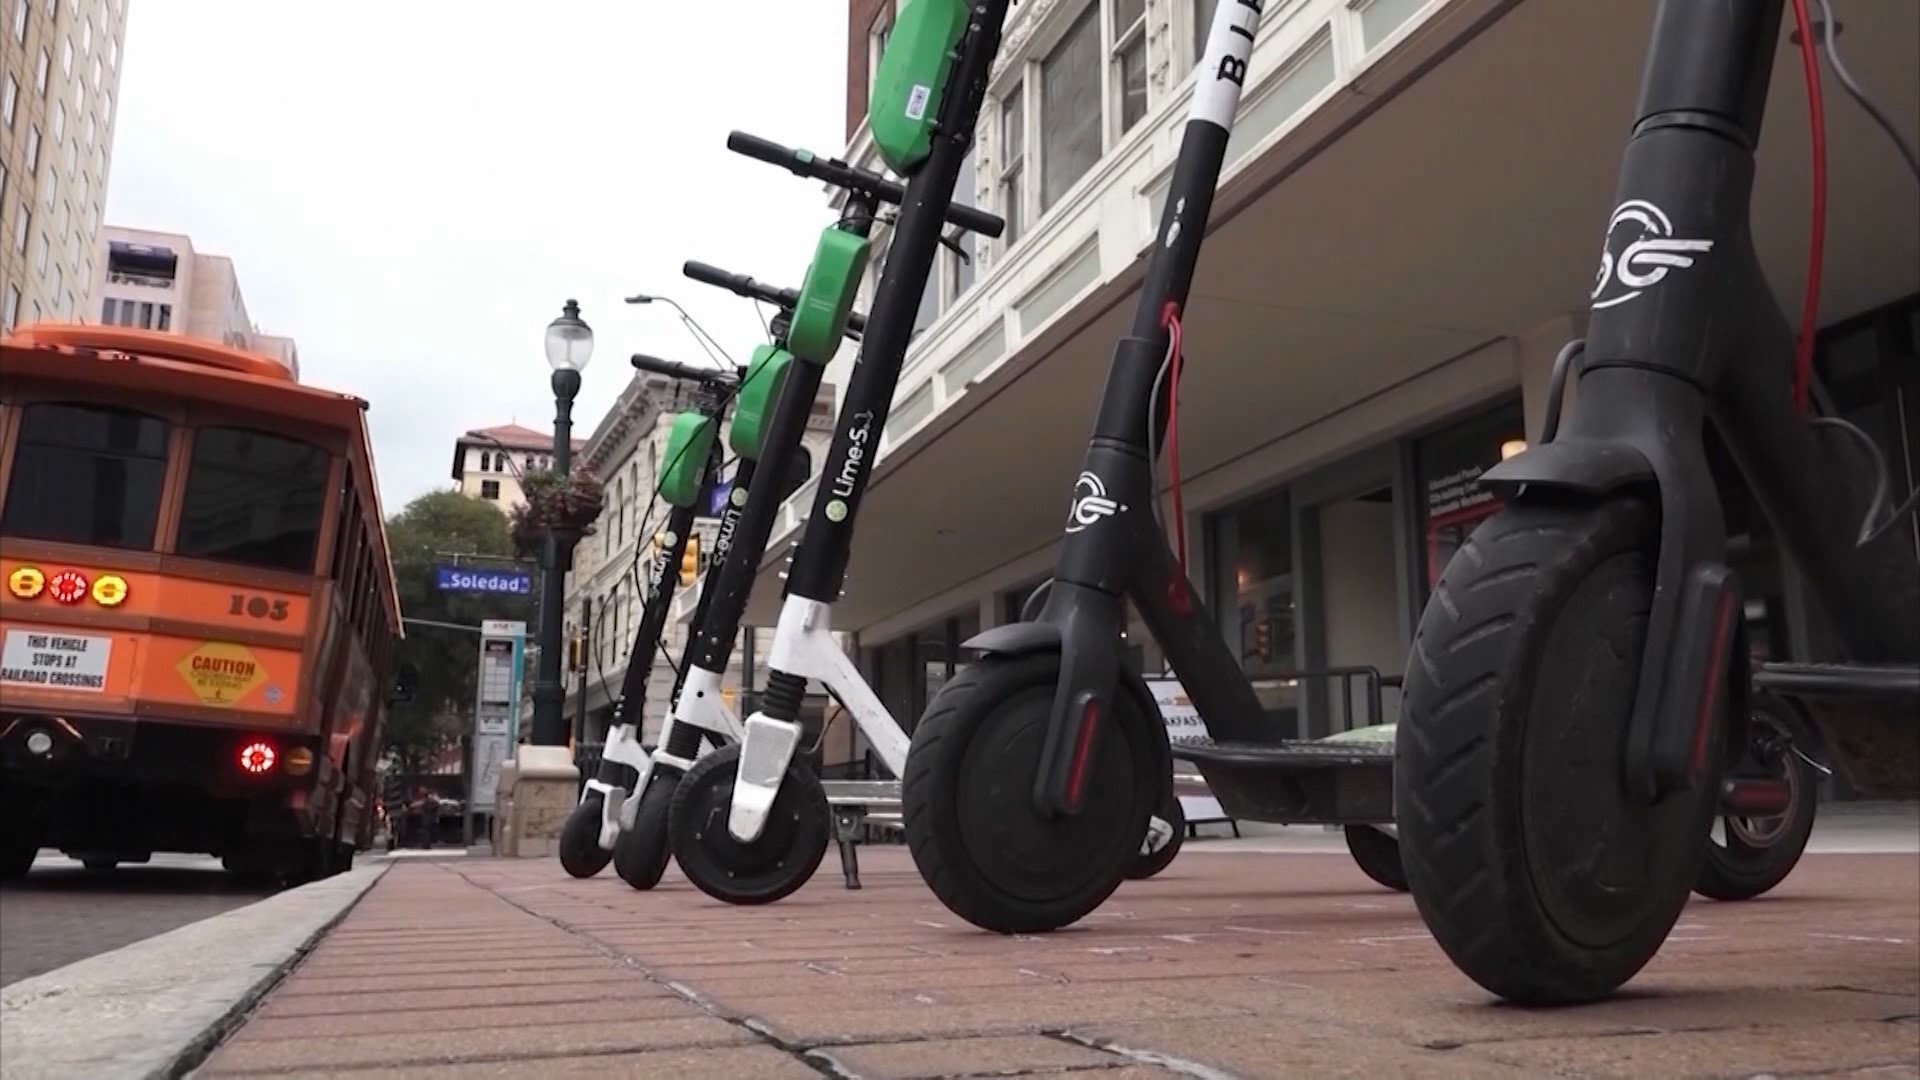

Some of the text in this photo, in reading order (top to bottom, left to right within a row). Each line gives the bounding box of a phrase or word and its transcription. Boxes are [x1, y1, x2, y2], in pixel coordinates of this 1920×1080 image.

[451, 573, 519, 592] Soledad
[228, 594, 289, 621] 105
[27, 635, 87, 652] THIS VEHICLE
[32, 653, 77, 668] STOPS AT
[191, 655, 255, 676] CAUTION
[1, 667, 103, 688] RAILROAD CROSSINGS
